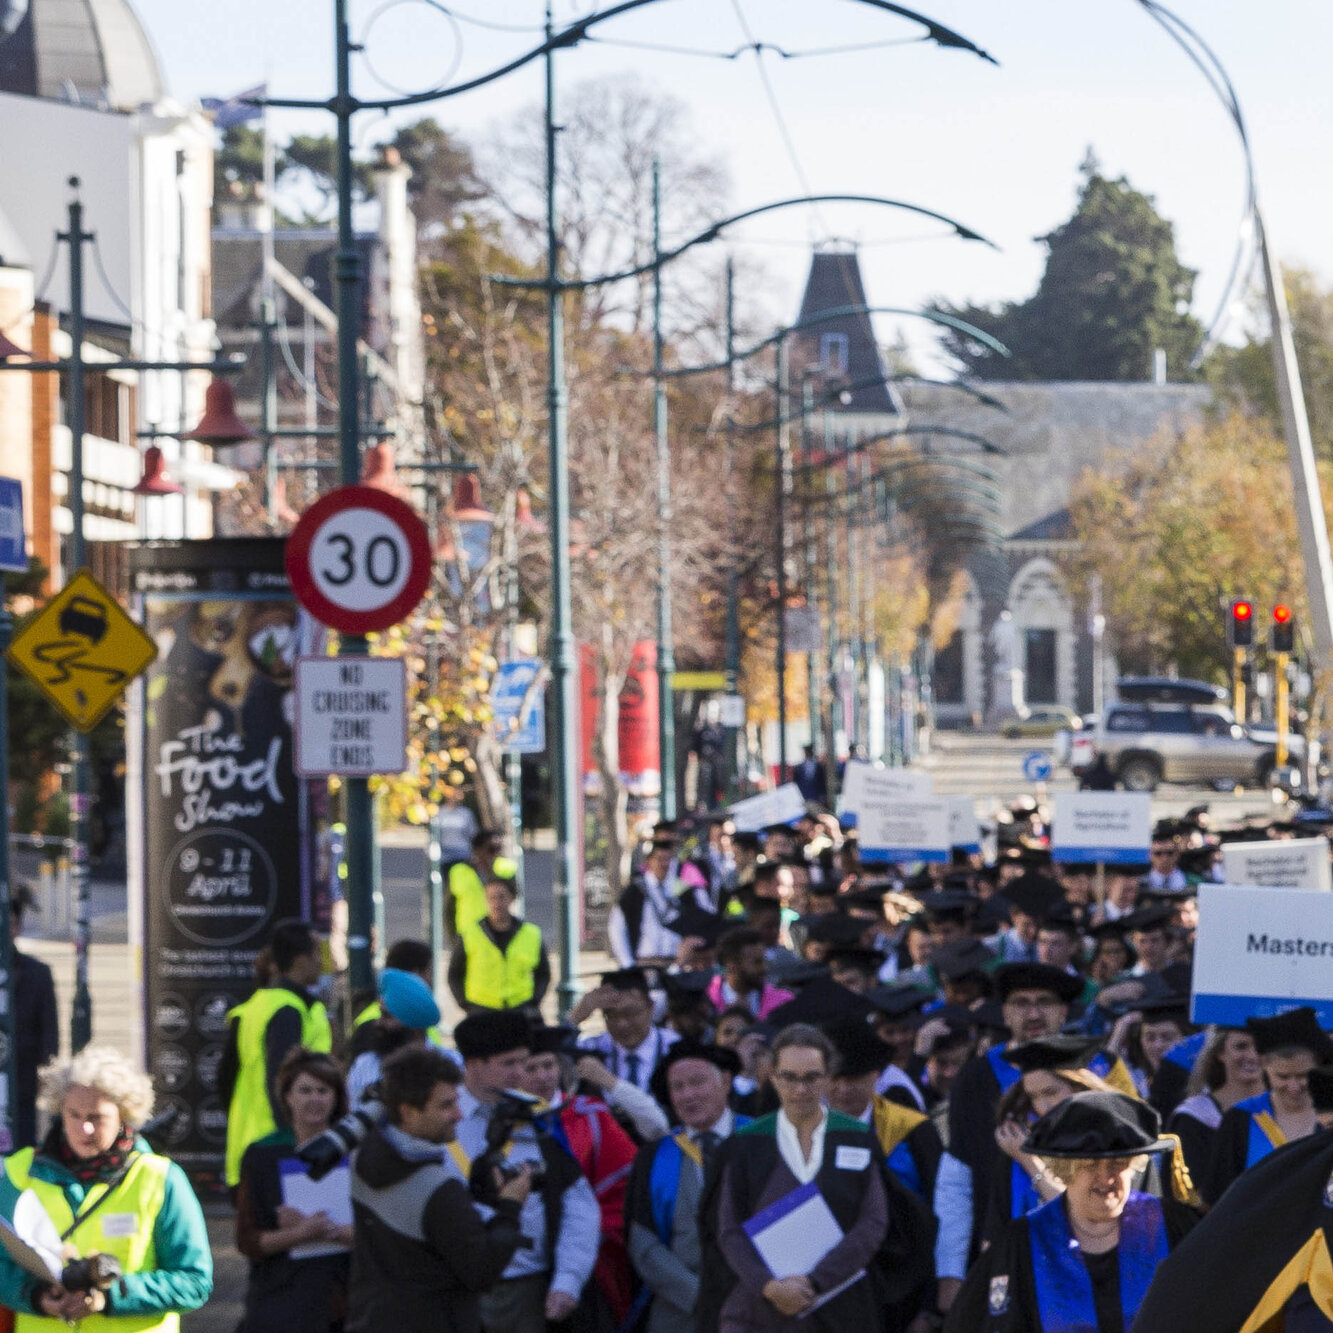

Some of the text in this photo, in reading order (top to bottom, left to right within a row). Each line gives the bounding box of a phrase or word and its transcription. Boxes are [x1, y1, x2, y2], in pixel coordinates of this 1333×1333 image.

[324, 533, 399, 587] 30
[341, 665, 363, 684] NO
[312, 690, 390, 713] CRUISING
[178, 723, 244, 751] The
[332, 718, 371, 738] ZONE
[155, 736, 284, 803] Food
[174, 788, 264, 832] Show
[179, 848, 200, 872] 9
